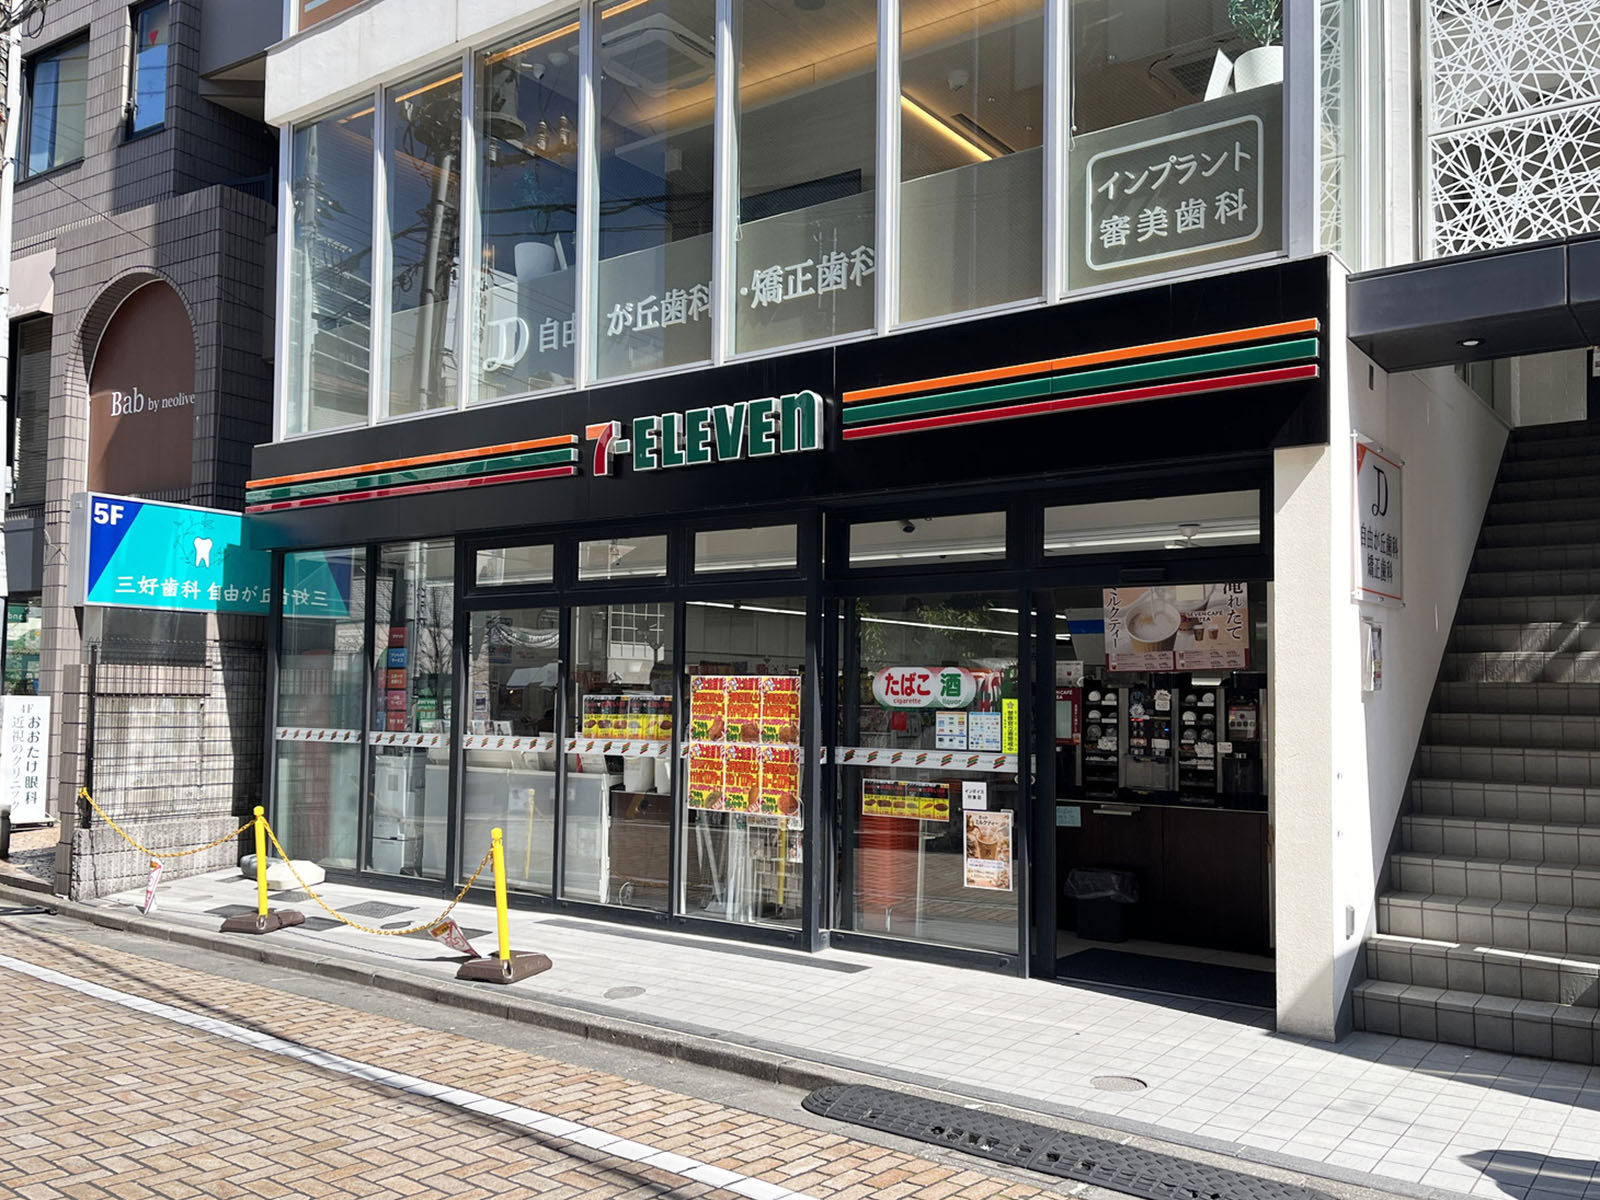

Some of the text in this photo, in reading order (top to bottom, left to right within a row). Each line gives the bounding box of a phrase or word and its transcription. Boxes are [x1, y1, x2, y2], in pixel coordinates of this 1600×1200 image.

[1097, 141, 1251, 199] インプラント
[1099, 188, 1248, 249] 審美歯科
[110, 387, 196, 417] Bab by neolive
[93, 502, 125, 525] 5F
[115, 575, 201, 601] 三好歯科
[884, 671, 962, 697] たばこ 酒
[893, 697, 922, 705] cigarette
[10, 716, 25, 812] 近視のクリニック
[24, 716, 42, 805] おおたけ眼科
